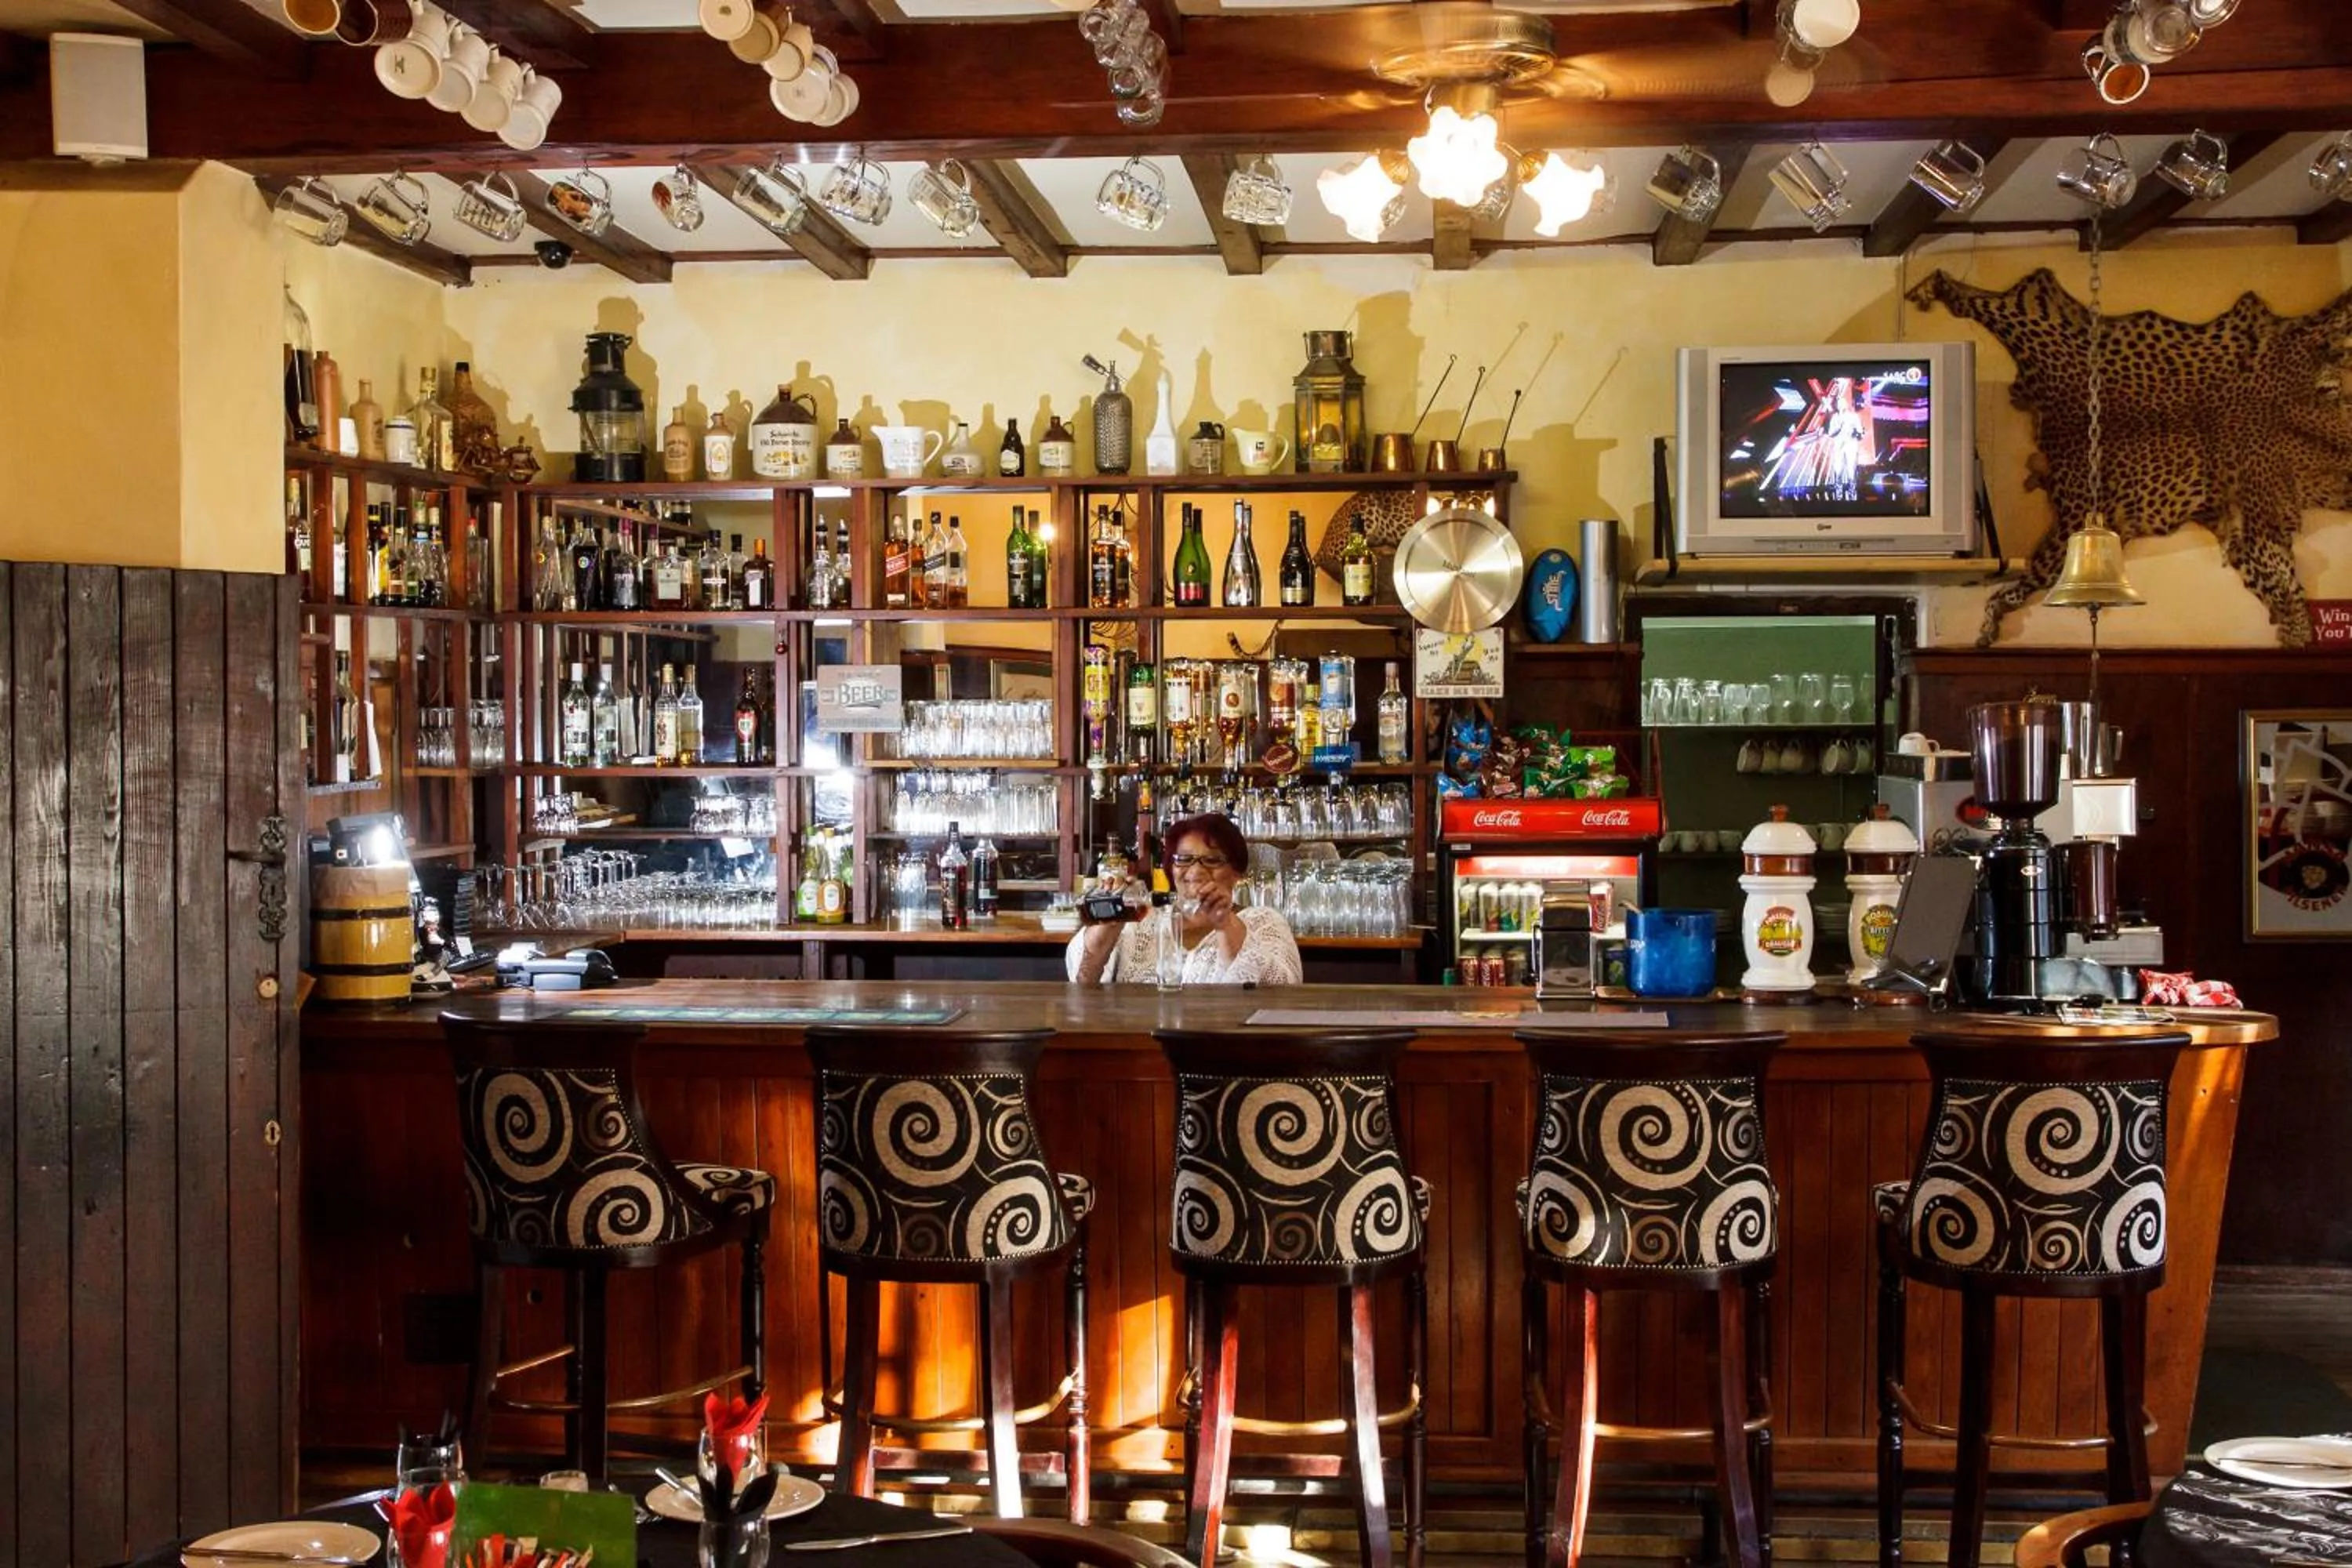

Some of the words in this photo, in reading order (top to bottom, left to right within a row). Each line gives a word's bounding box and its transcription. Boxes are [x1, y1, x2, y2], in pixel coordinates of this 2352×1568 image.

[2314, 625, 2344, 641] You
[839, 683, 884, 705] BEER
[1473, 810, 1523, 827] Coca-Cola
[1581, 809, 1631, 826] Coca-Cola
